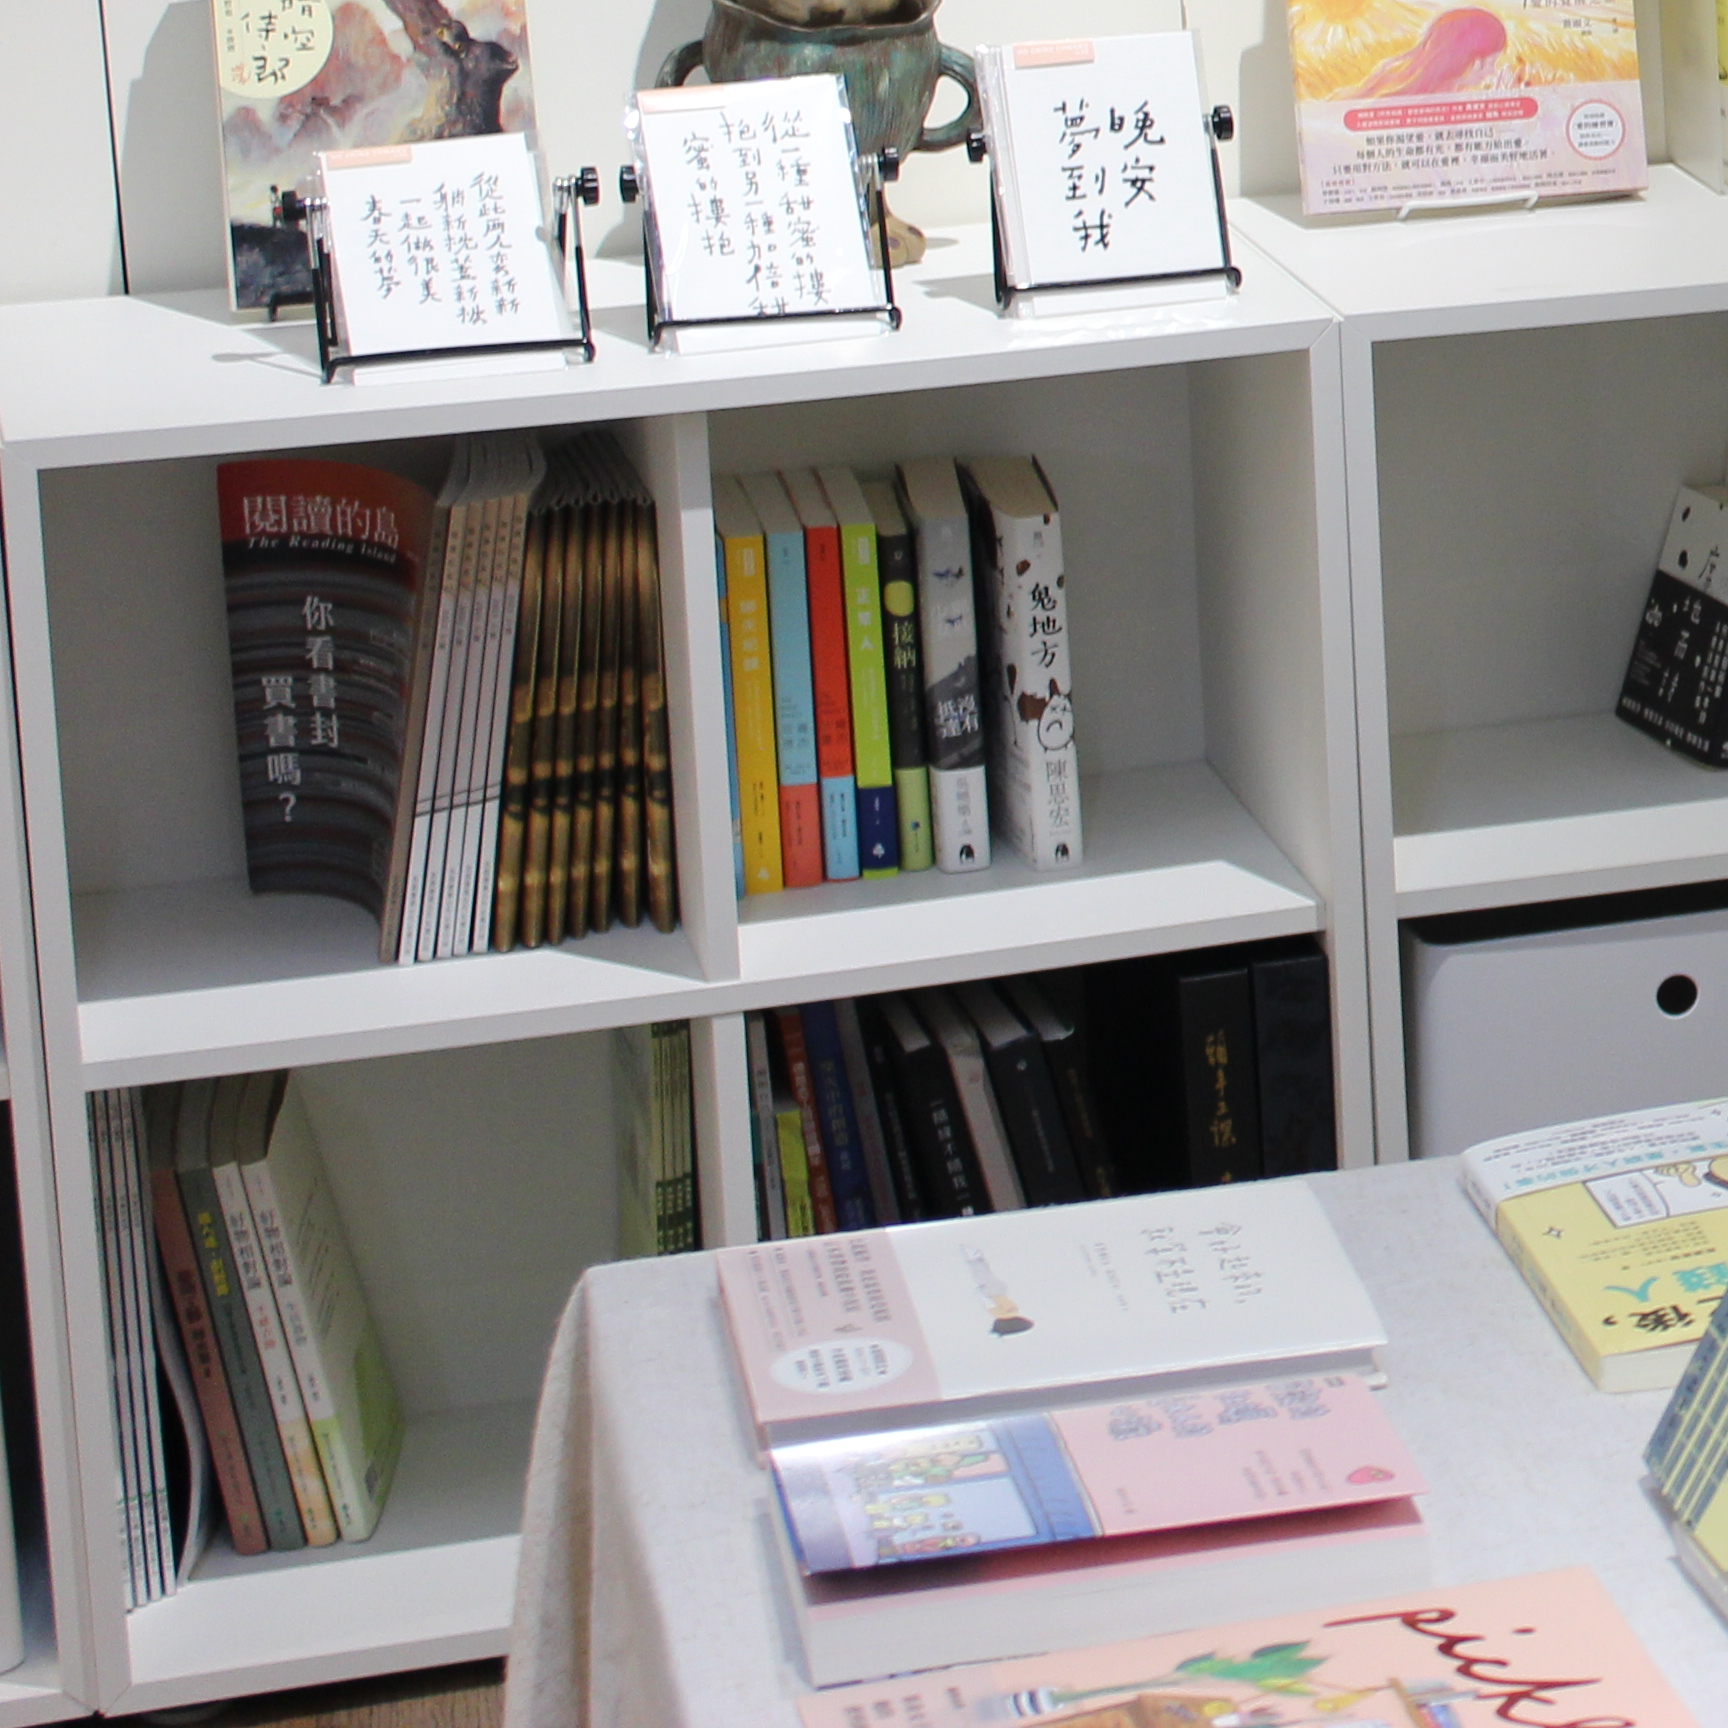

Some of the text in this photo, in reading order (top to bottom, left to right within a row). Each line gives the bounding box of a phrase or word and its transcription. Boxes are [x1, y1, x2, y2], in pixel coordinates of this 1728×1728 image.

[1053, 97, 1113, 253] 夢到我
[1109, 100, 1166, 208] 晚安
[243, 494, 400, 550] 閱讀的島
[302, 595, 340, 749] 你看書封
[891, 621, 916, 670] 接納
[1029, 581, 1064, 669] 鬼地方
[260, 675, 301, 823] 買書嗎？
[1045, 760, 1071, 829] 陳思宏
